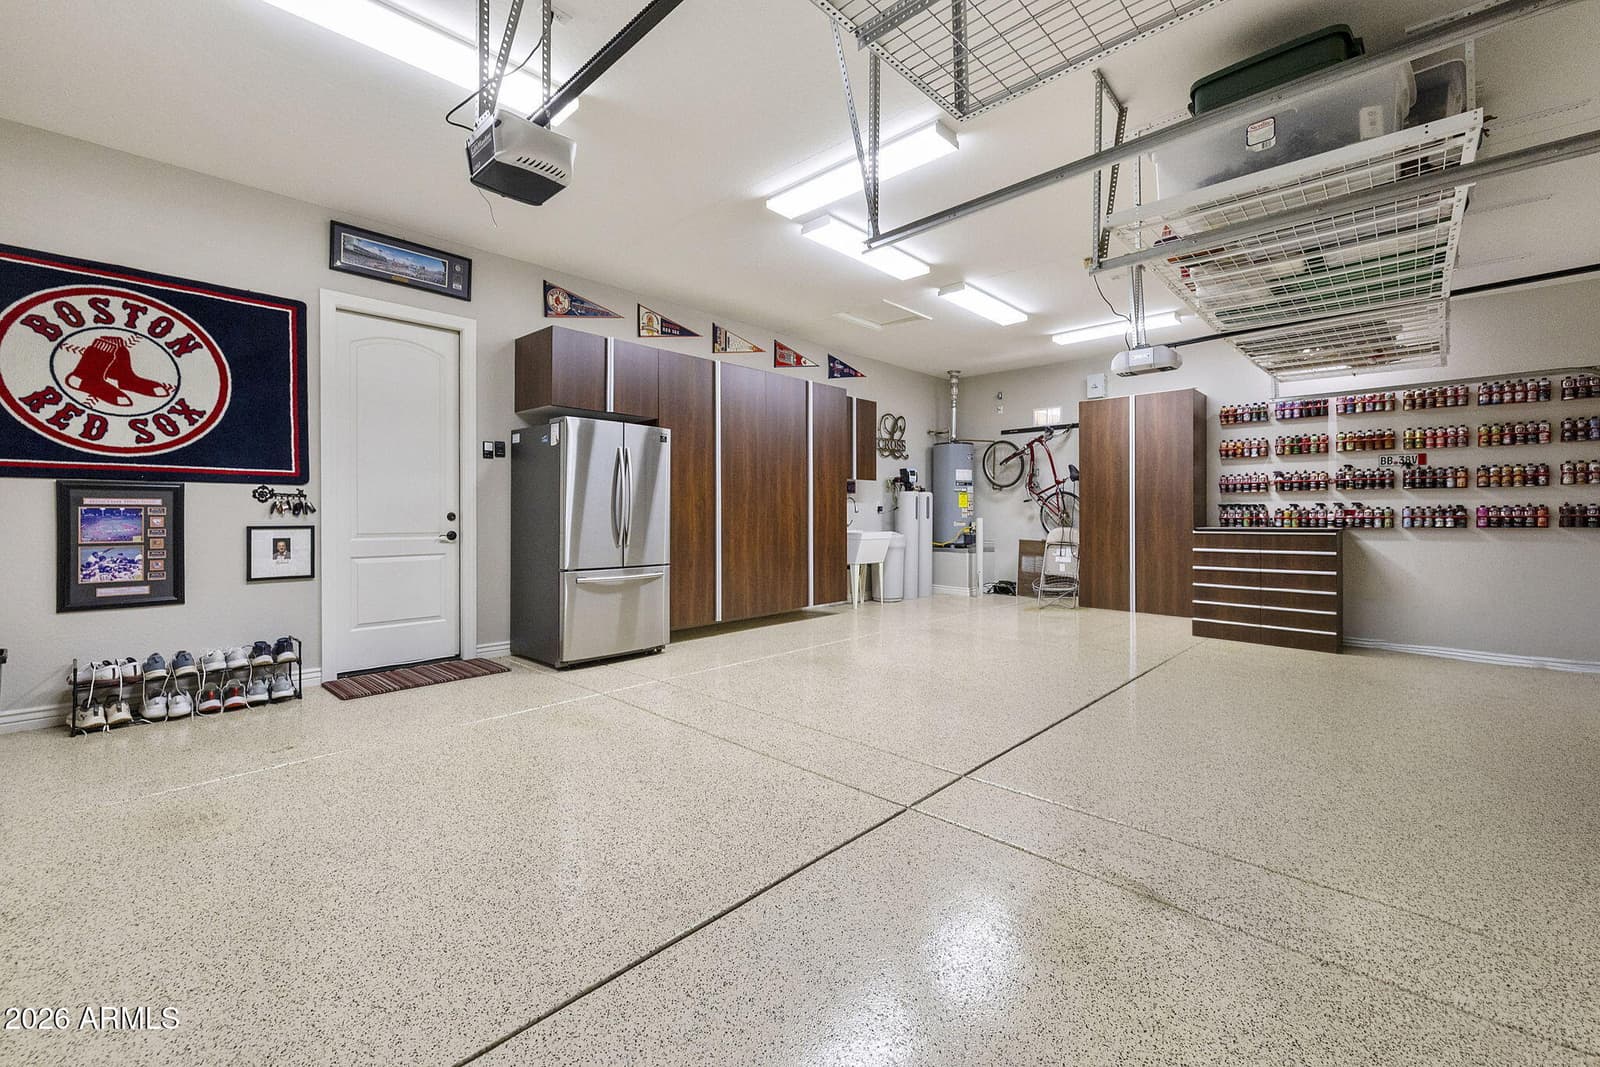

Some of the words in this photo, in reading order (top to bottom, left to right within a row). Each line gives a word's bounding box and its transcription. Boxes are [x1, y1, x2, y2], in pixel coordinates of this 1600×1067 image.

[20, 297, 204, 358] BOSTON
[19, 385, 109, 441] RED
[129, 398, 207, 444] SOX
[878, 439, 906, 452] CROSS
